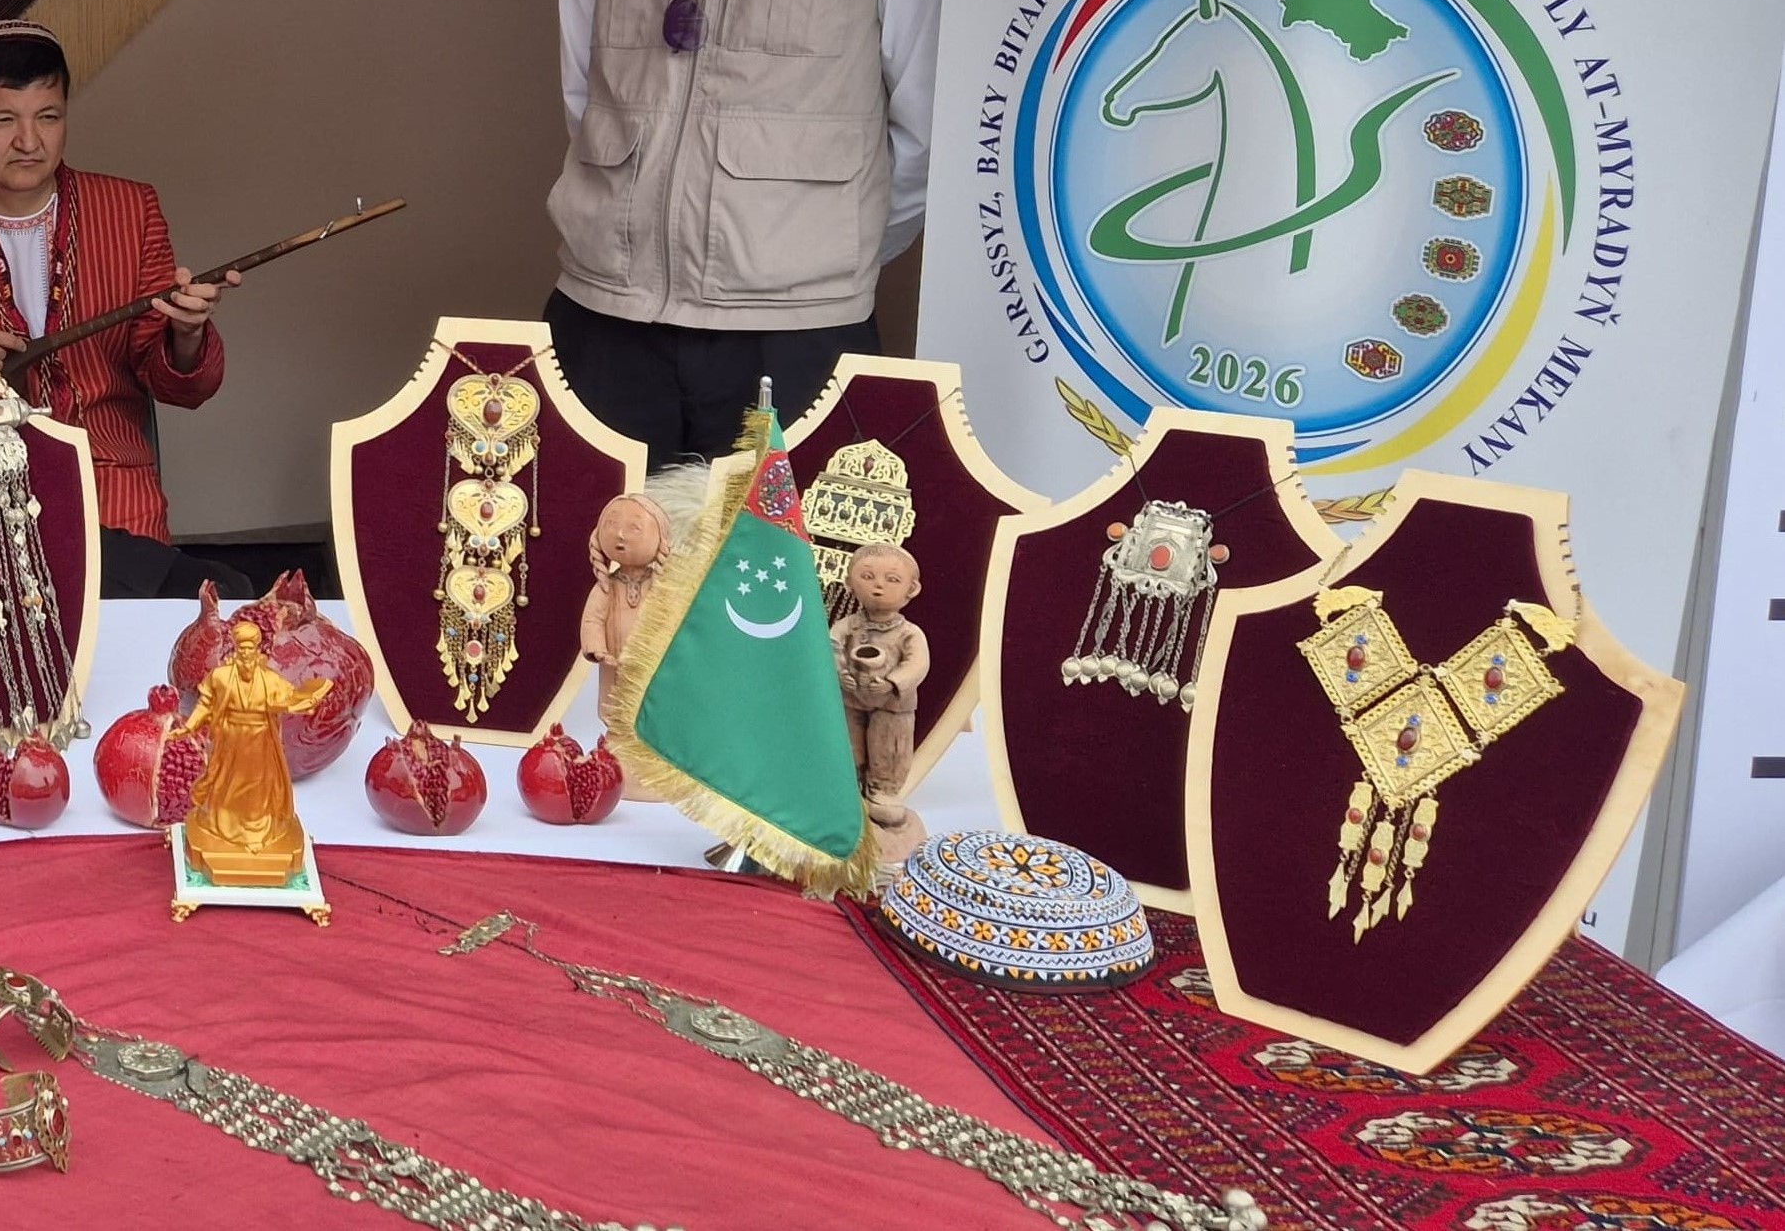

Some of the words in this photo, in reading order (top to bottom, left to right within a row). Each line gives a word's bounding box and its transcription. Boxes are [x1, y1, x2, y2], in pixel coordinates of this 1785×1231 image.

[976, 83, 1009, 176] BAKY
[1460, 333, 1594, 477] MEKANY
[1187, 345, 1305, 406] 2026
